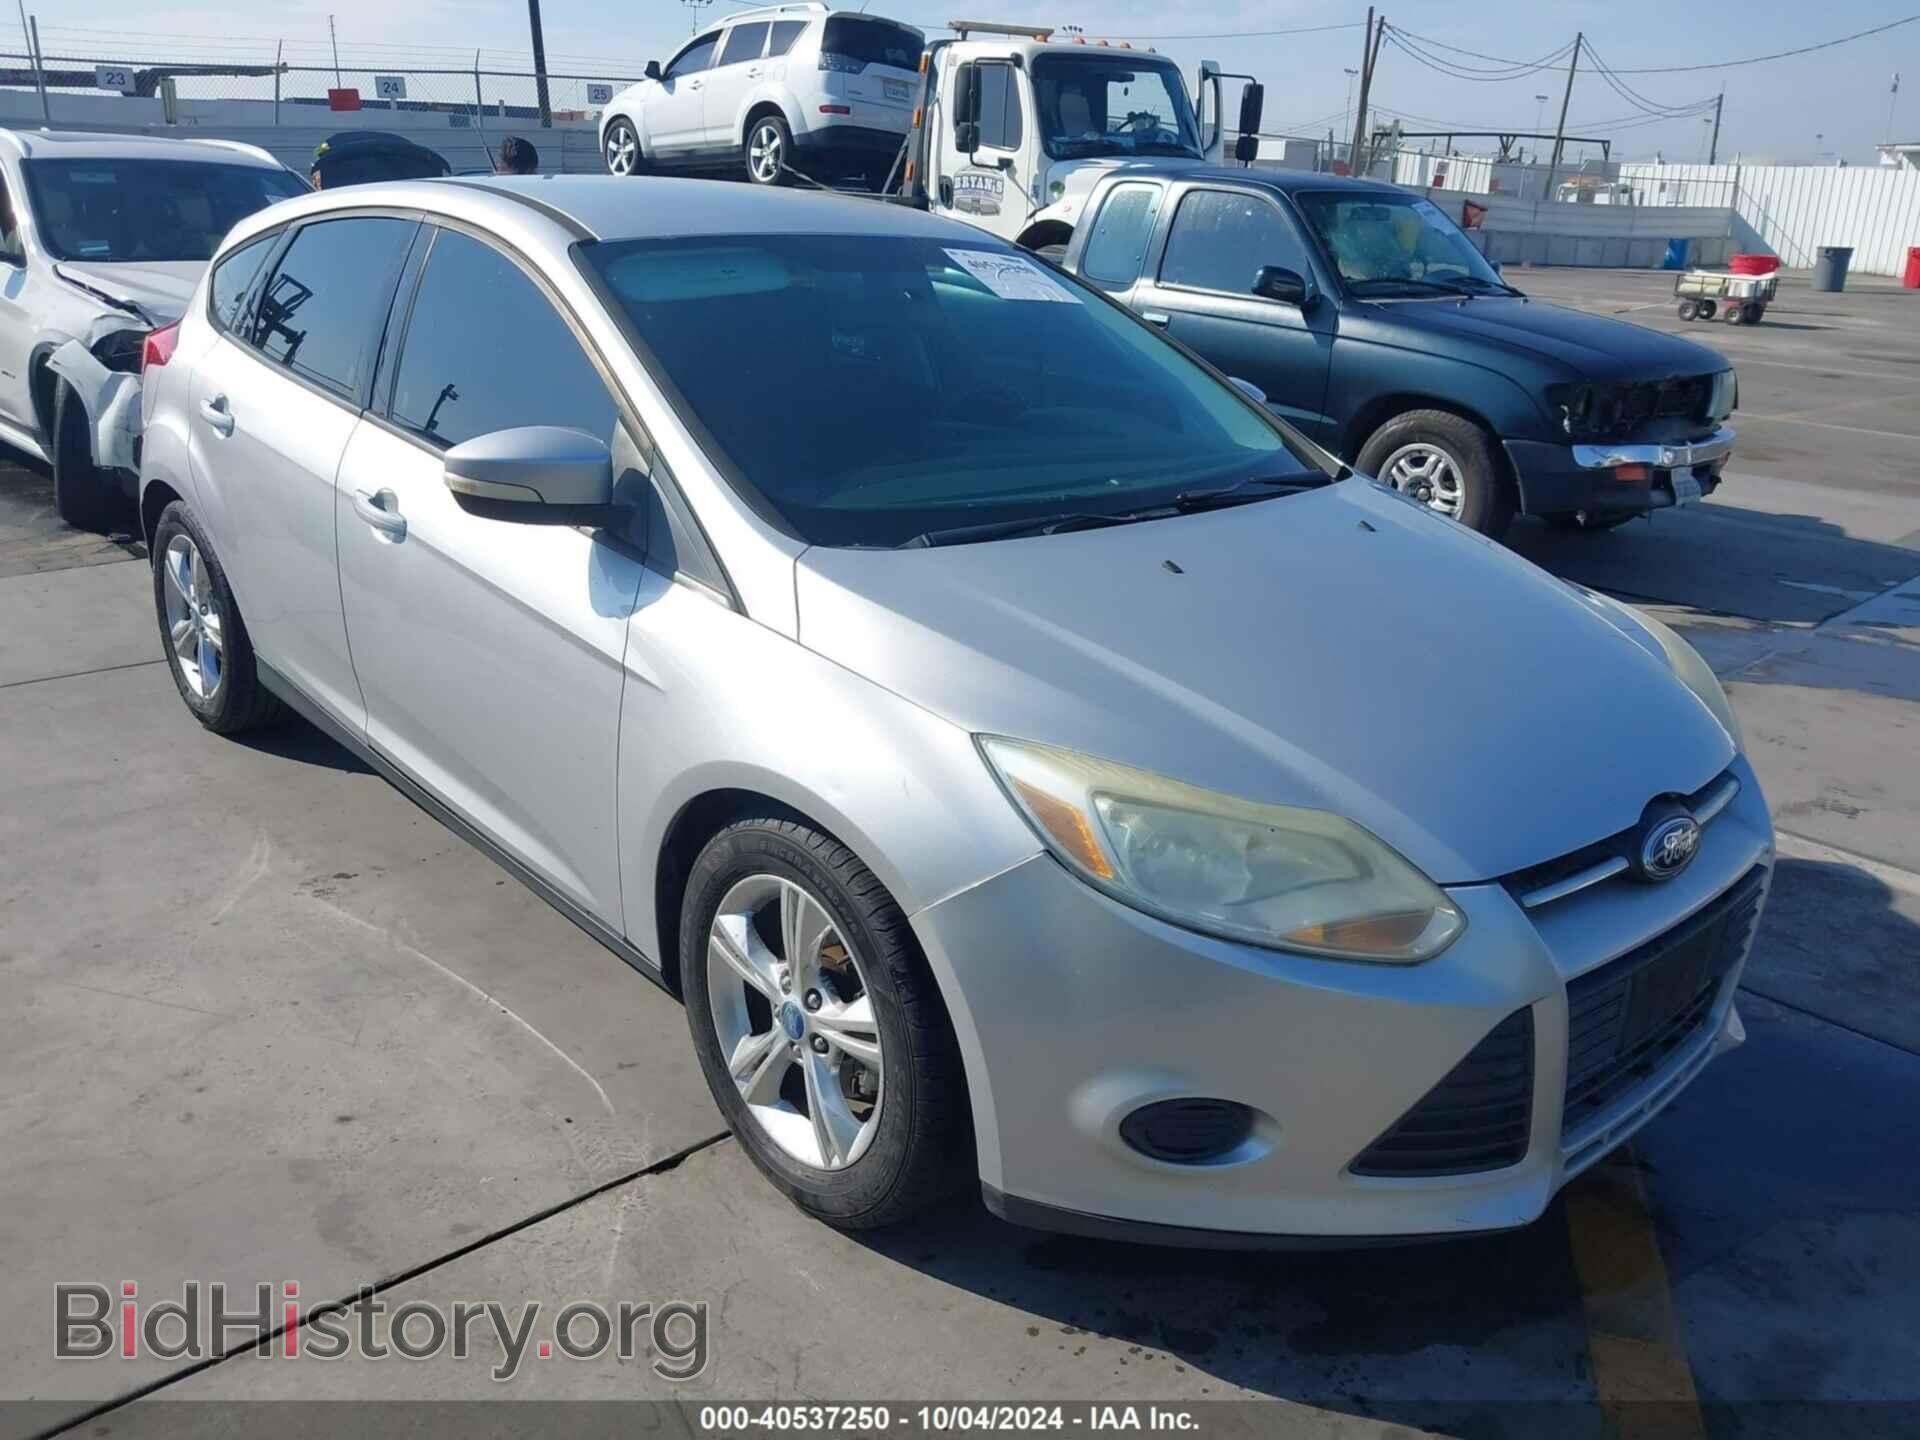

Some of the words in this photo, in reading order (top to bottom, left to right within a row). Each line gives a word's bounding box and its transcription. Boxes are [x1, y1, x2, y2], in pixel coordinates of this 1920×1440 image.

[105, 71, 126, 86] 23
[383, 81, 399, 94] 24
[593, 88, 608, 100] 25
[953, 175, 1004, 195] BRYAN'S
[1655, 828, 1698, 865] Ford
